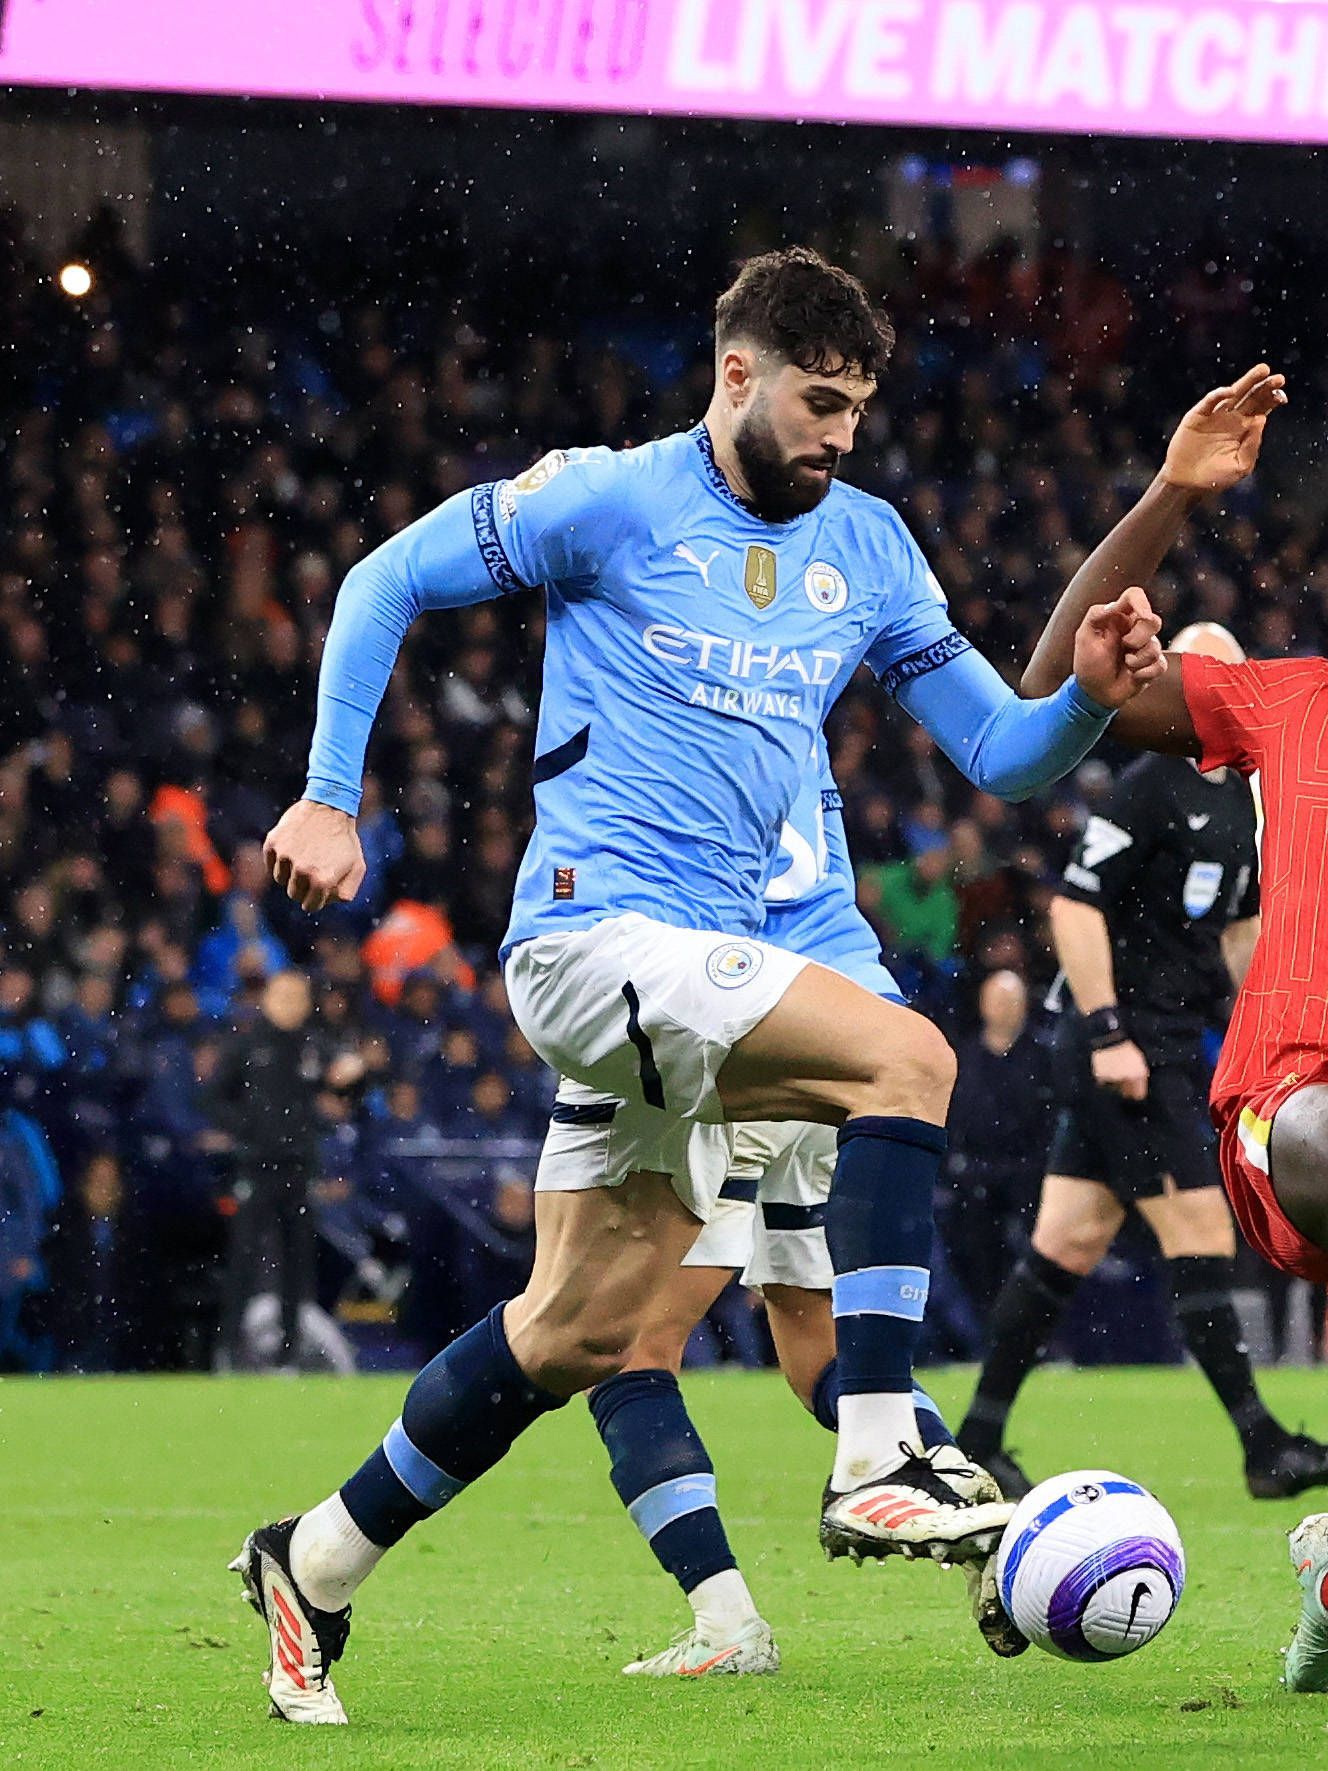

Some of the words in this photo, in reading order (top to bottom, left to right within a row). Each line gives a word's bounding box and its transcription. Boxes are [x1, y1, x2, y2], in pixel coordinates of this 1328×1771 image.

[667, 0, 914, 98] LIVE
[751, 584, 770, 597] FIFA
[643, 624, 843, 686] ETIHAD
[689, 682, 801, 718] AIRWAYS
